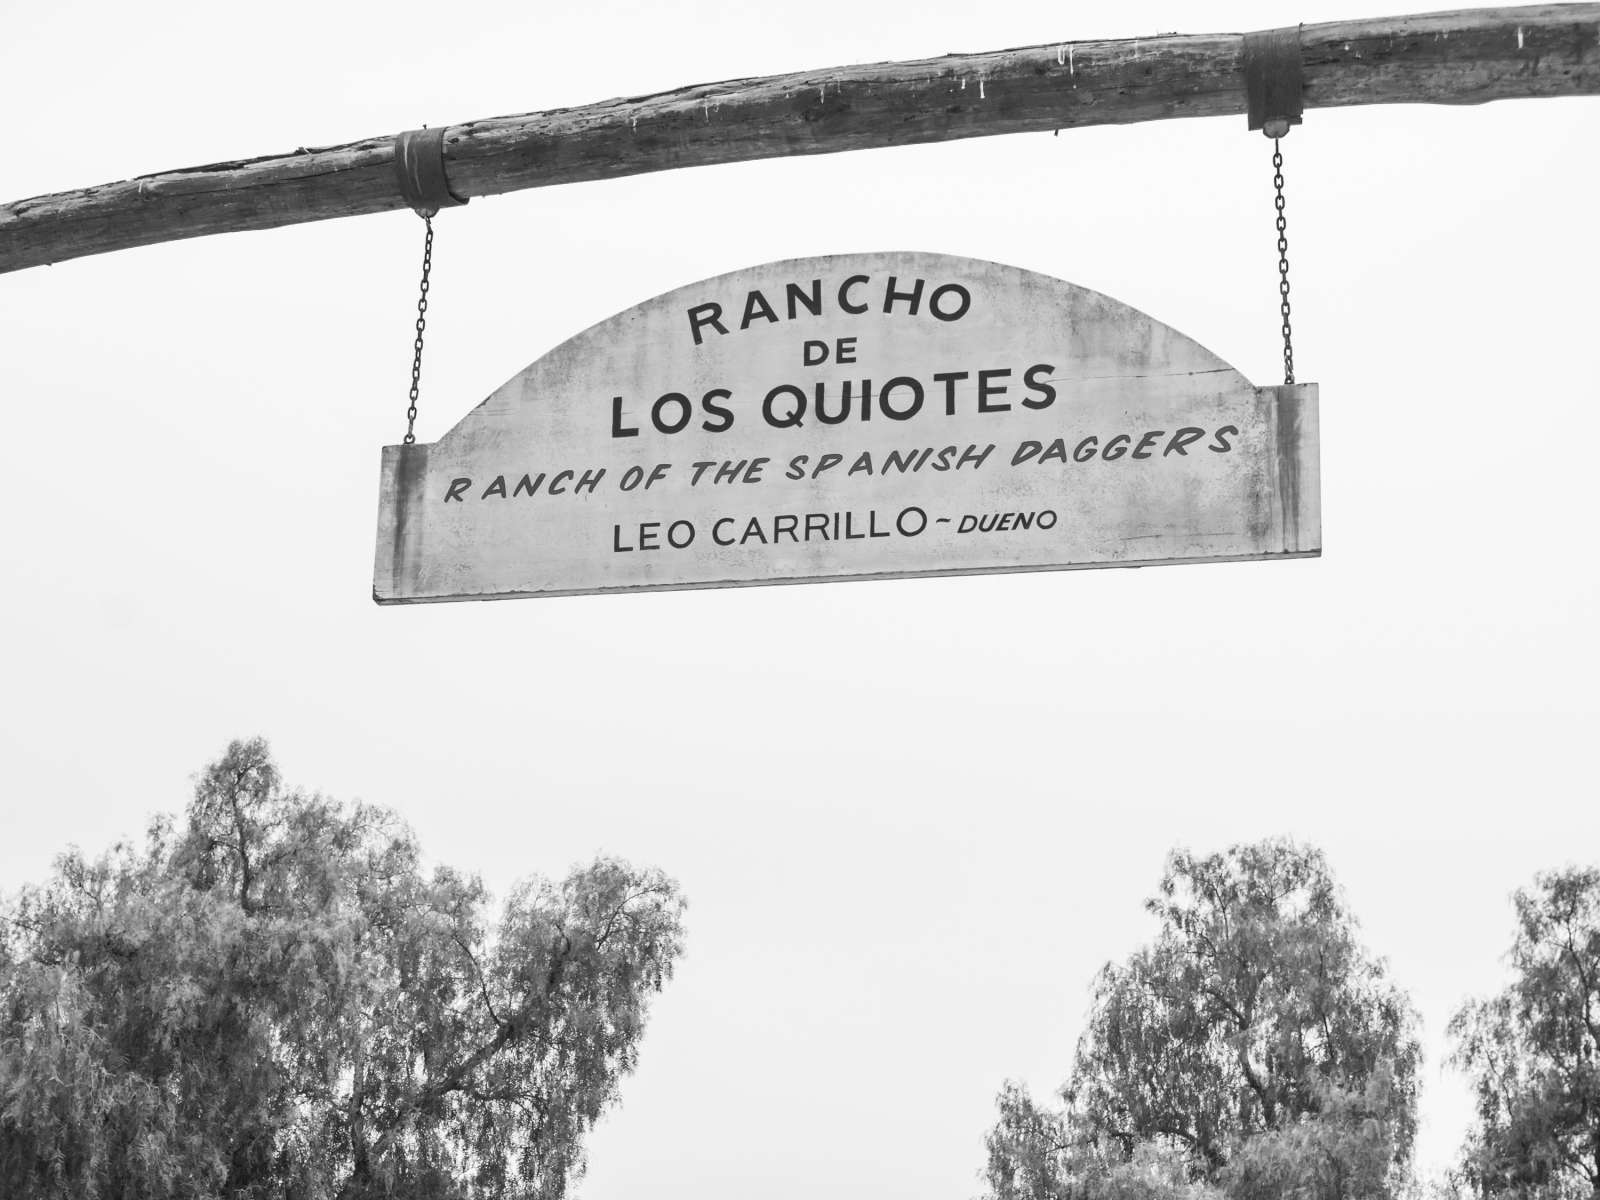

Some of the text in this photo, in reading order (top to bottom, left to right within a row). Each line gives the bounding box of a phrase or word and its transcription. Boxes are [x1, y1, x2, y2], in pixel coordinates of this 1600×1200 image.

[687, 275, 971, 345] RANCHO
[803, 337, 857, 366] DE
[611, 364, 1056, 438] LOS QUIOTES
[444, 425, 1239, 502] RANCH OF THE SPANISH DAGGERS
[613, 519, 696, 552] LEO
